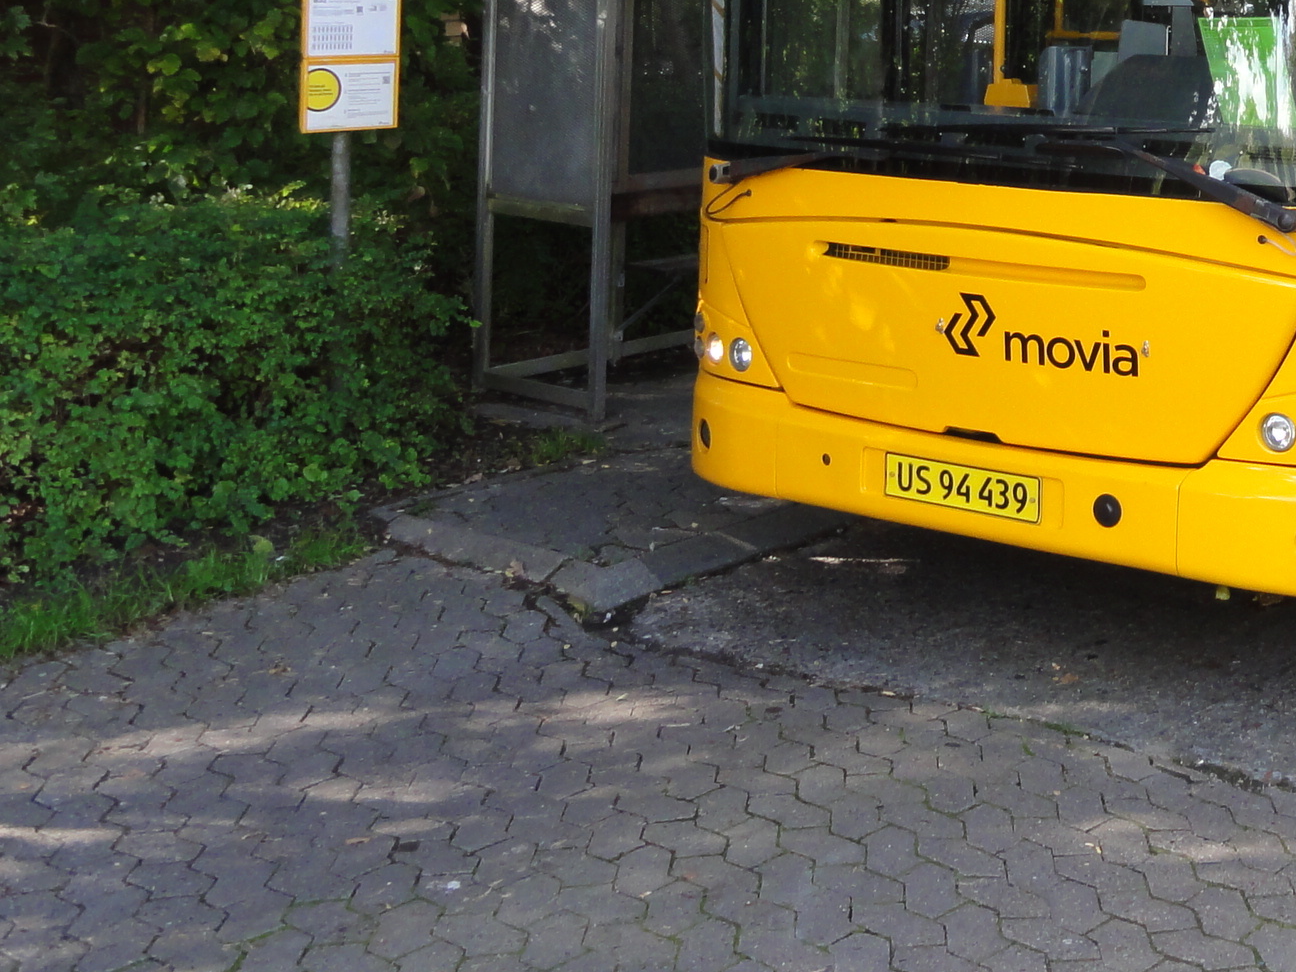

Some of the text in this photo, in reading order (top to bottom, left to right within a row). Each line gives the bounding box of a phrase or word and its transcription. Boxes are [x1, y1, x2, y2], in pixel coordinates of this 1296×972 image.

[1004, 330, 1139, 377] movia
[897, 461, 1028, 514] US 94 439
